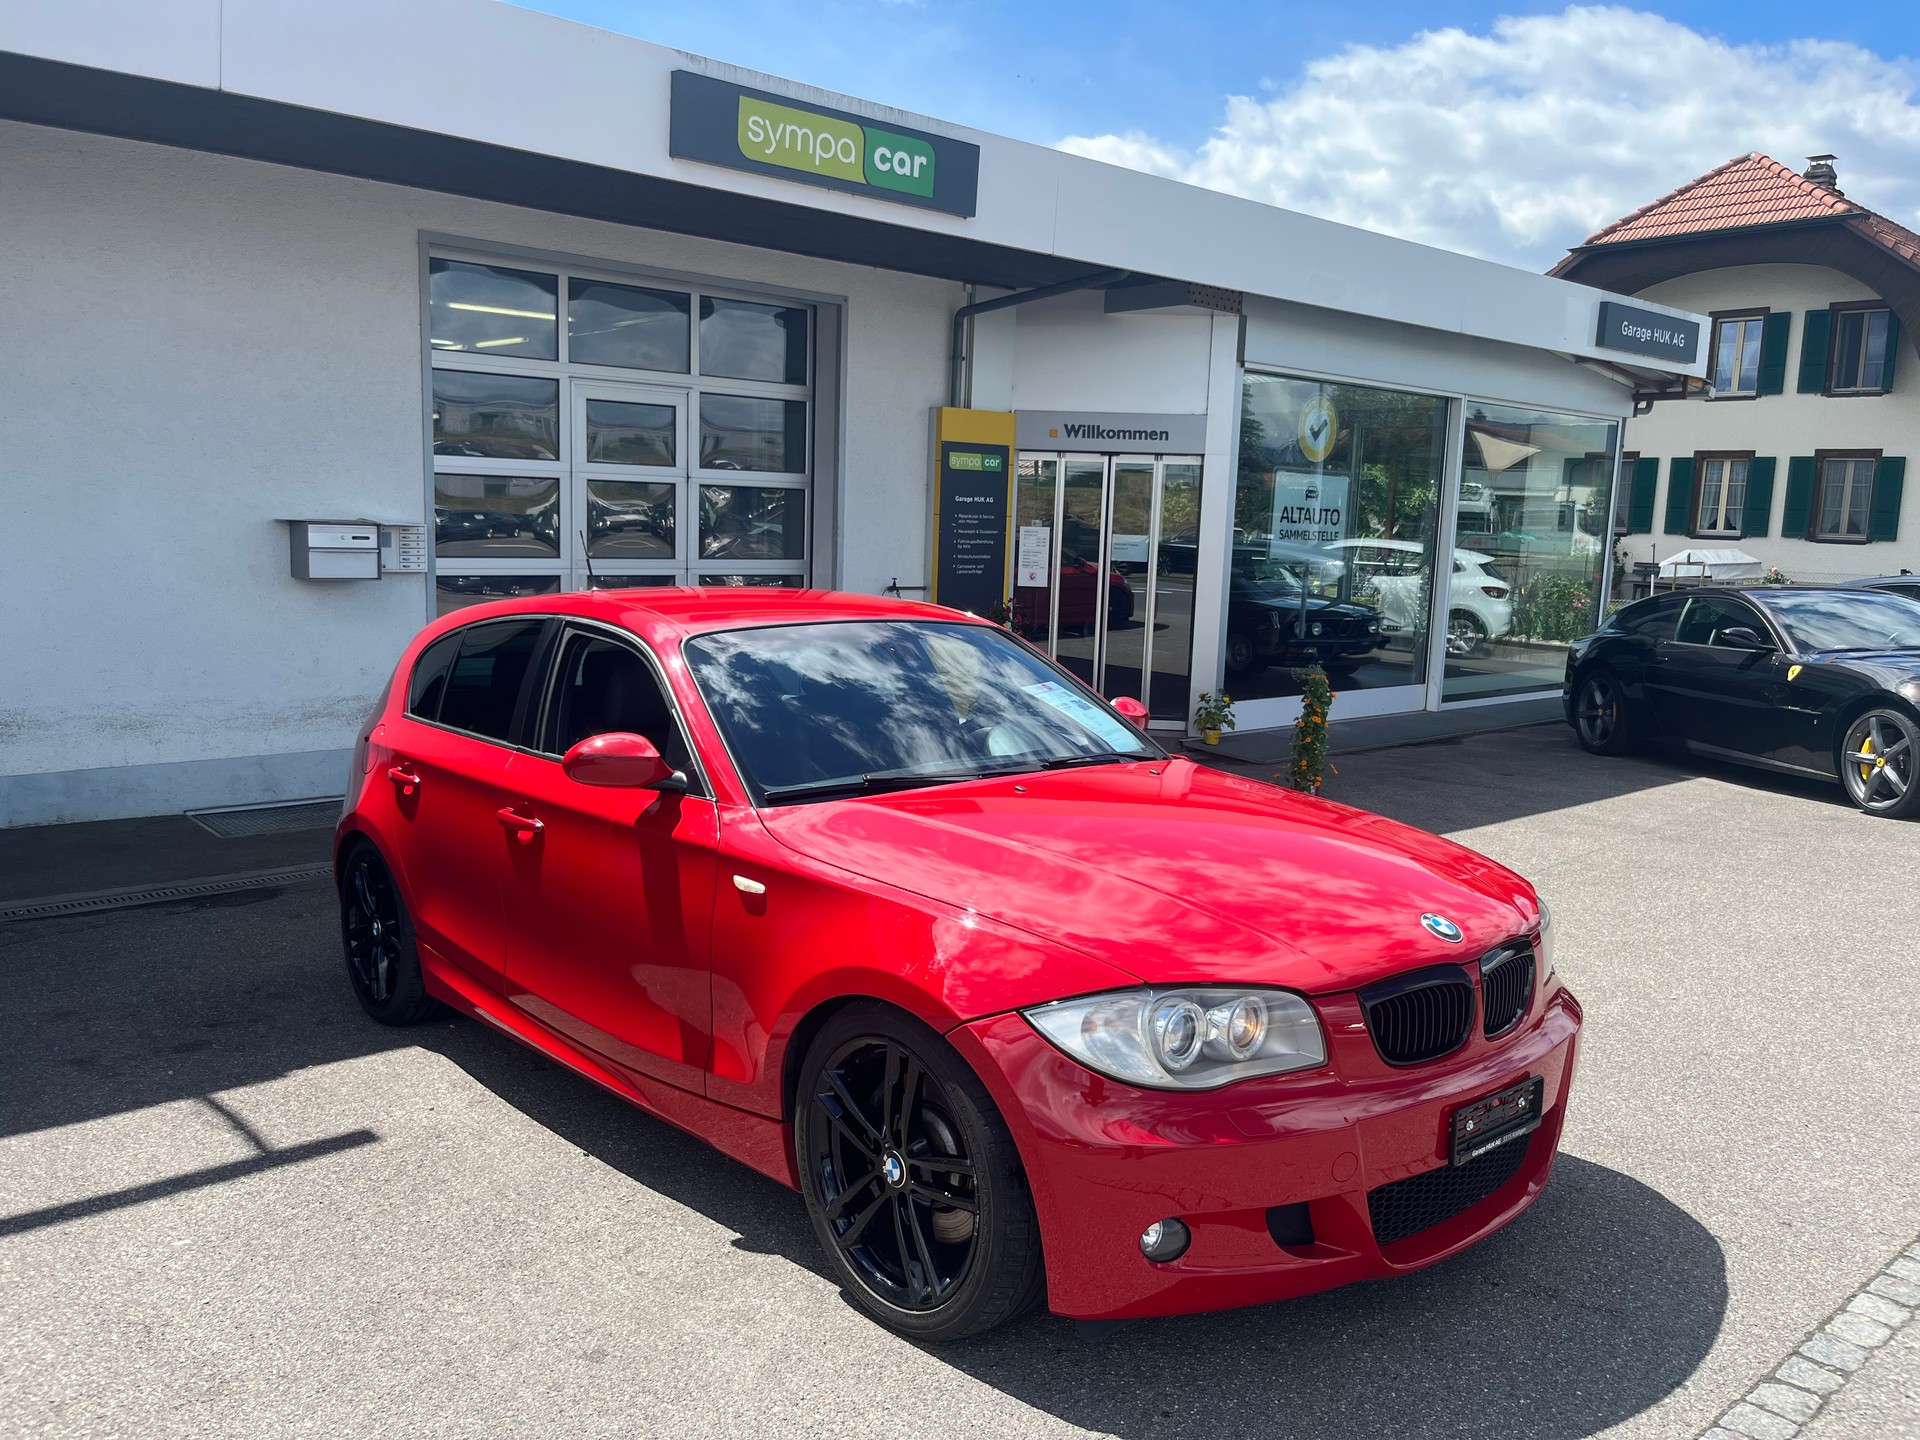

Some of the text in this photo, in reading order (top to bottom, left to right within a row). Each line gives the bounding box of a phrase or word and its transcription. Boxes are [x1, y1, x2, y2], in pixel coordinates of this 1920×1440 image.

[747, 115, 927, 178] sympa car
[1621, 321, 1685, 347] Garage HUK AG
[1063, 423, 1169, 441] Willkommen
[951, 456, 1000, 469] sympa car
[954, 495, 973, 503] Garage
[1279, 505, 1341, 526] ALTAUTO
[1278, 528, 1340, 542] SAMMELSTELLE
